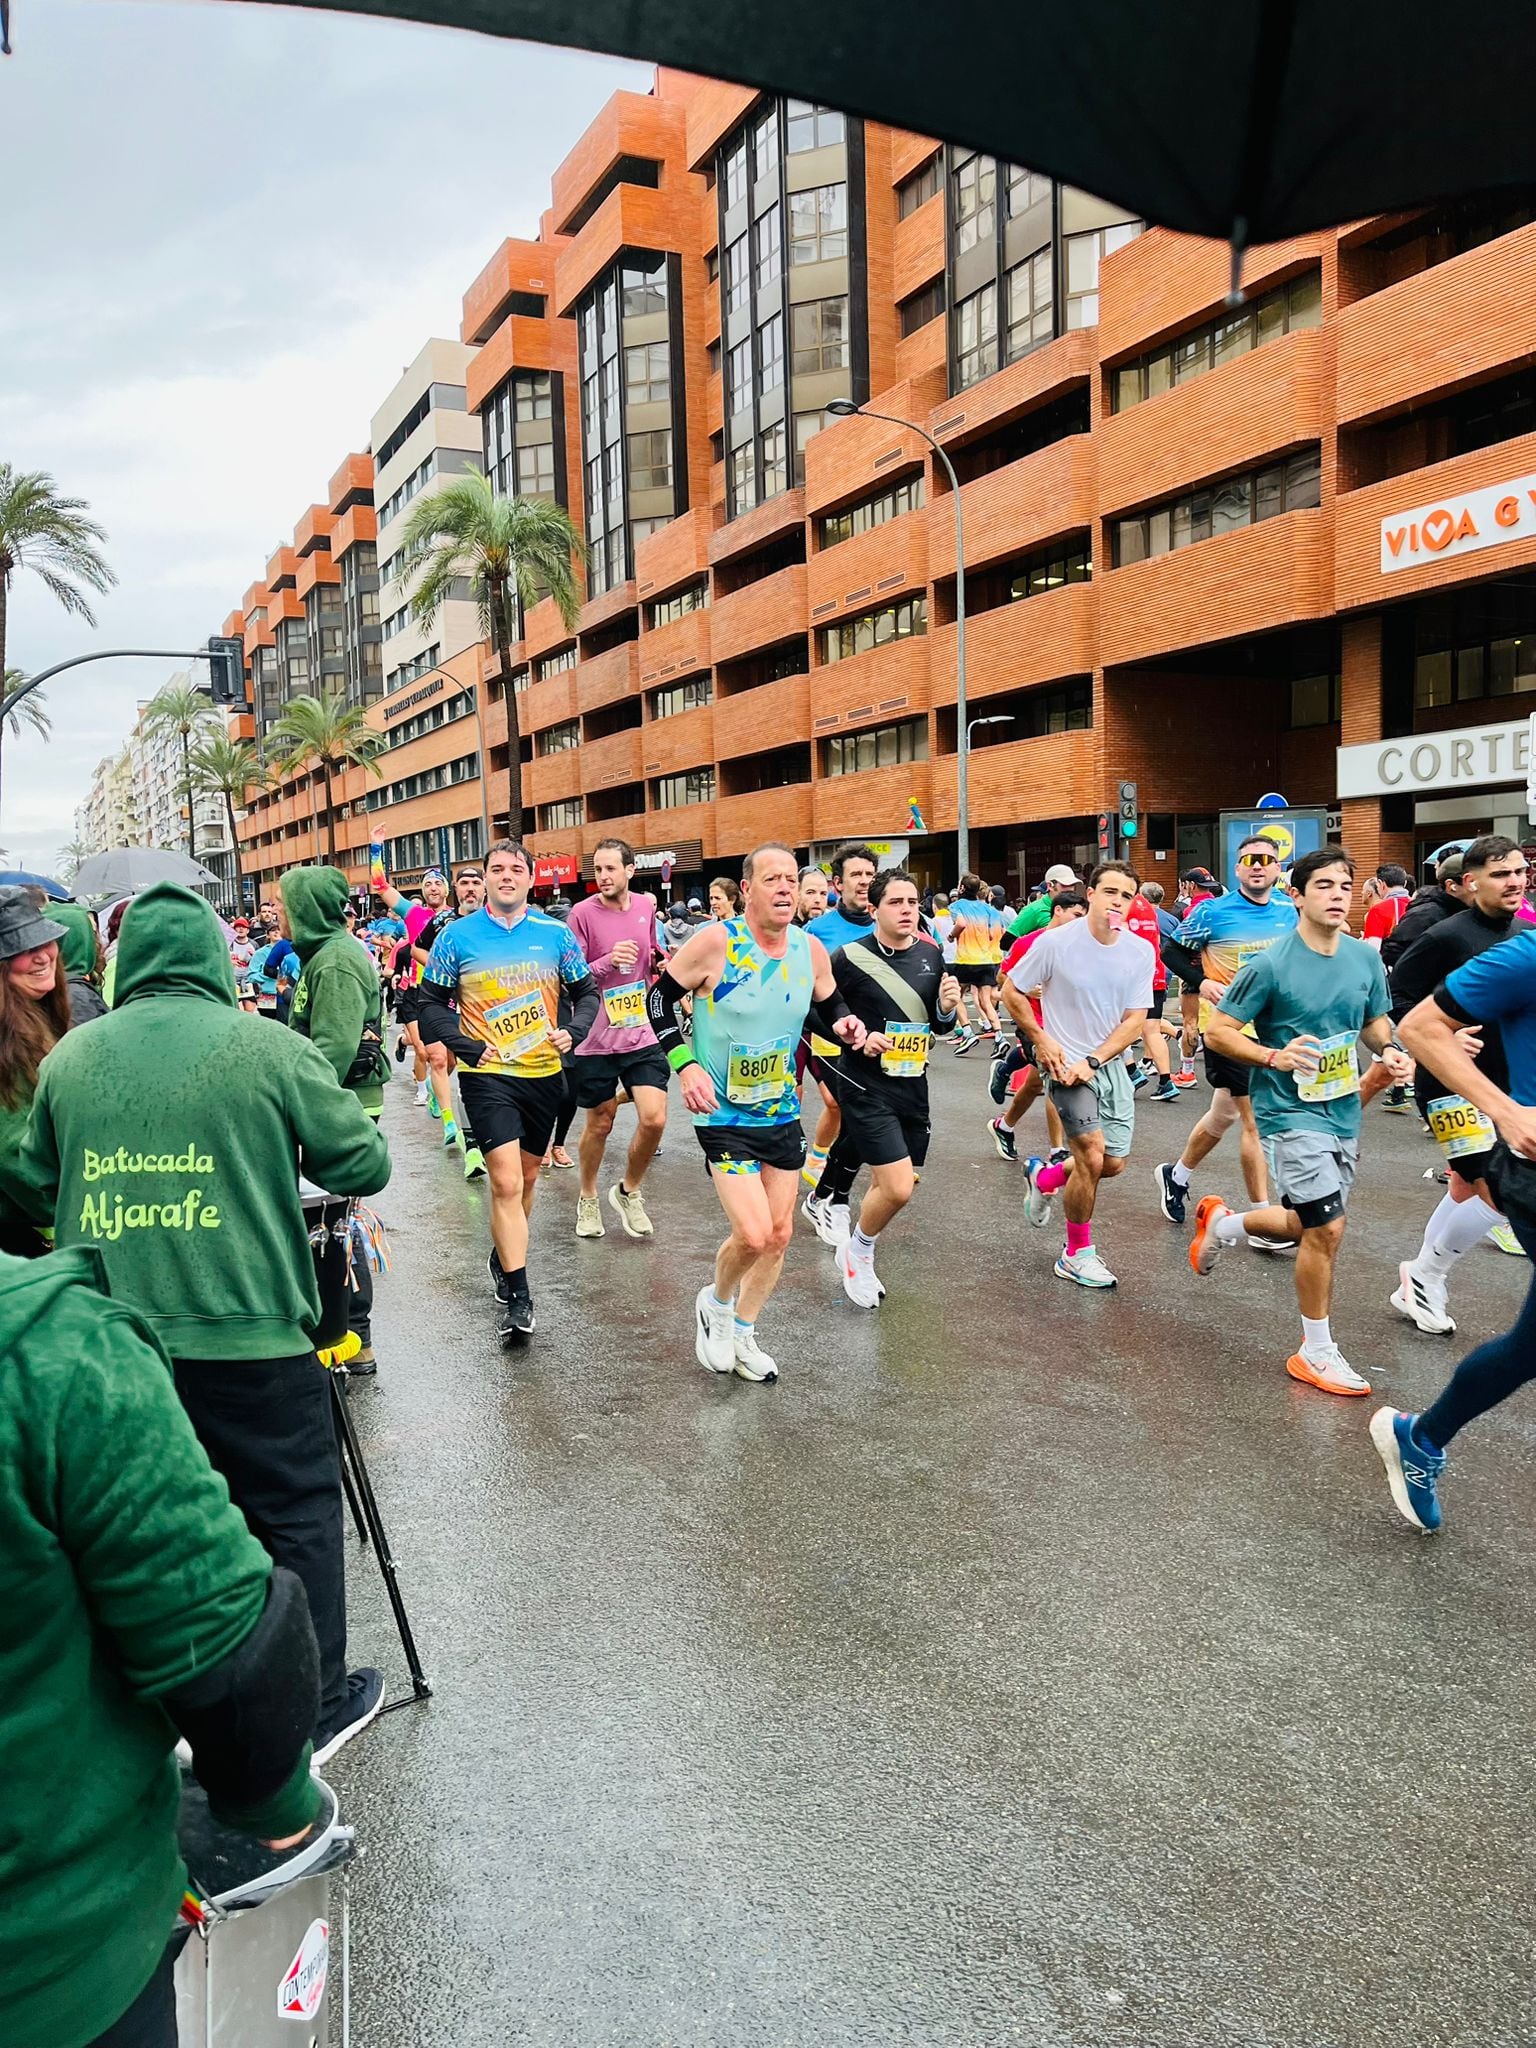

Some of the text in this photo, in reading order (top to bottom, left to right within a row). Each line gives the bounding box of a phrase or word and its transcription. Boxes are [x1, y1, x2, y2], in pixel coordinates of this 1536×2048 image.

[1377, 730, 1530, 785] CORTE
[609, 992, 642, 1013] 17927
[494, 1005, 539, 1037] 18726
[892, 1035, 927, 1053] 14451
[740, 1054, 778, 1078] 8807
[1318, 1047, 1349, 1074] 0244
[82, 1142, 216, 1182] Batucada
[79, 1188, 222, 1241] Aljarafe
